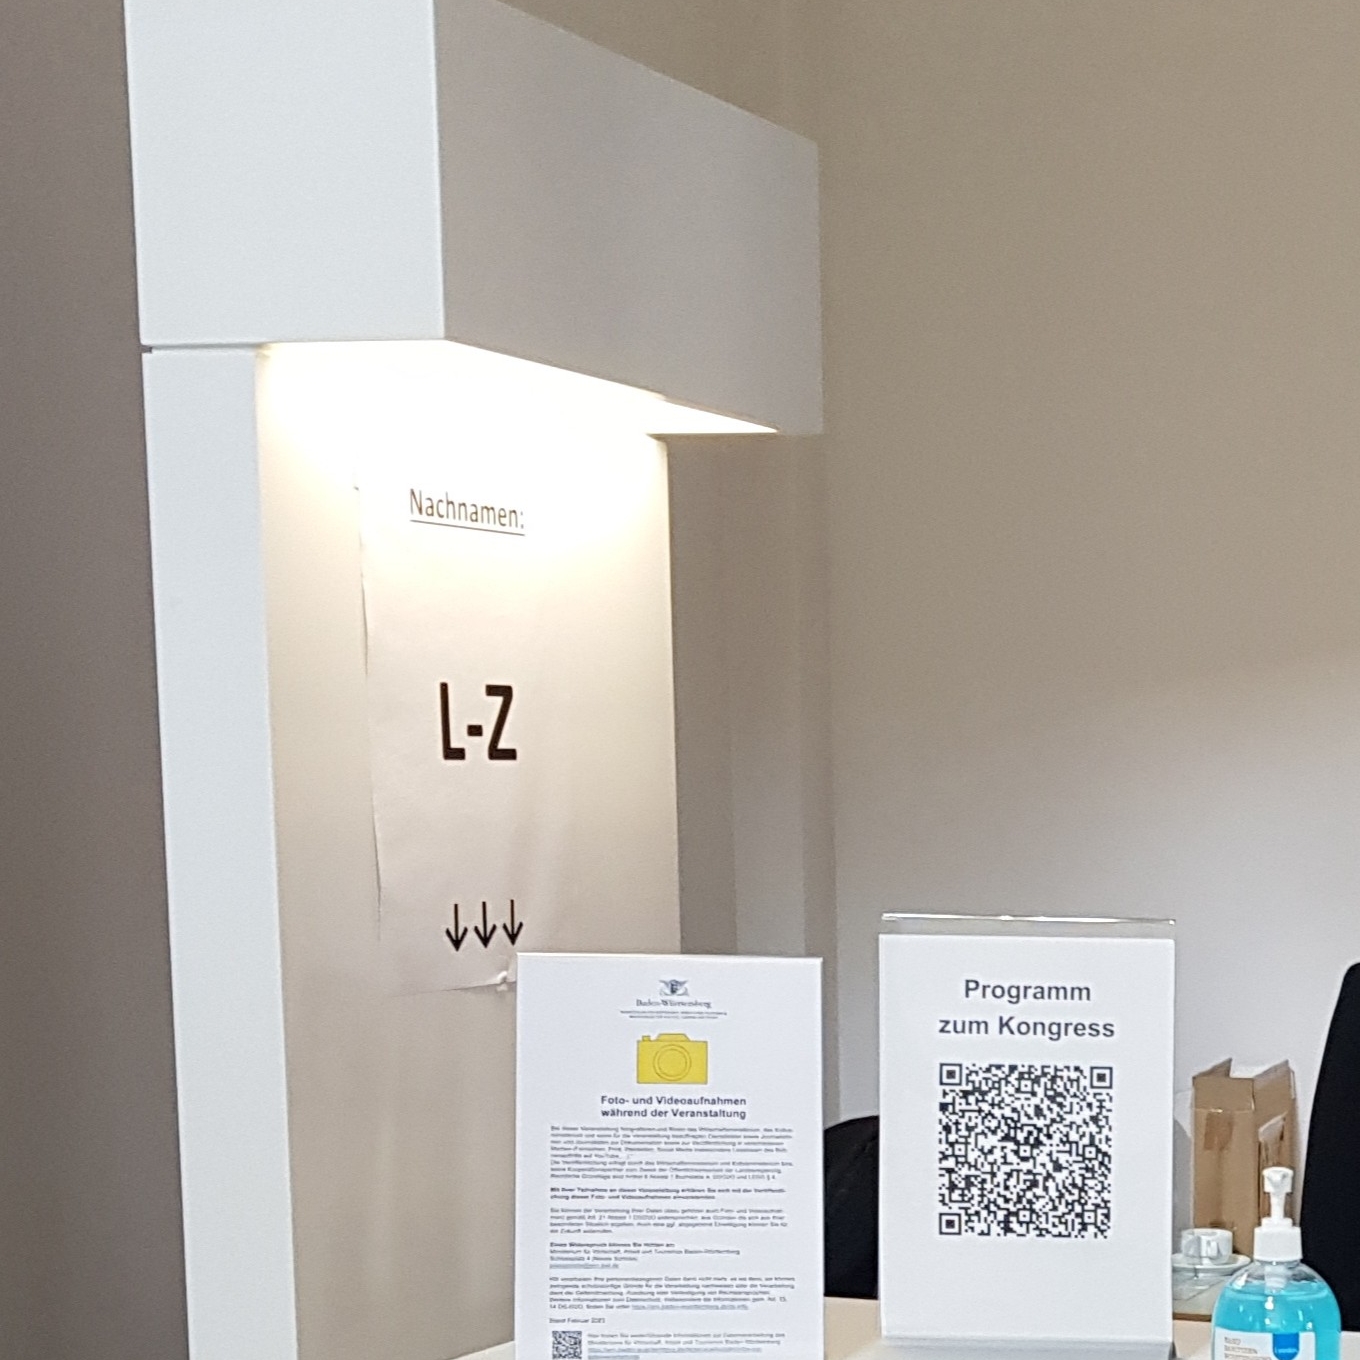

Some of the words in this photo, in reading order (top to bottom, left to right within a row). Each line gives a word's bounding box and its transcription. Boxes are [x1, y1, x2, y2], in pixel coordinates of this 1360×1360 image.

[410, 488, 525, 530] Nachnamen:
[440, 681, 517, 761] L-Z
[964, 979, 1091, 1005] Programm
[938, 1018, 989, 1035] zum
[998, 1015, 1116, 1041] Kongress
[600, 1095, 630, 1105] Foto-
[632, 1096, 653, 1105] und
[655, 1096, 747, 1106] Videoaufnahmen
[600, 1108, 648, 1118] während
[650, 1109, 669, 1118] der
[670, 1108, 747, 1121] Veranstaltung
